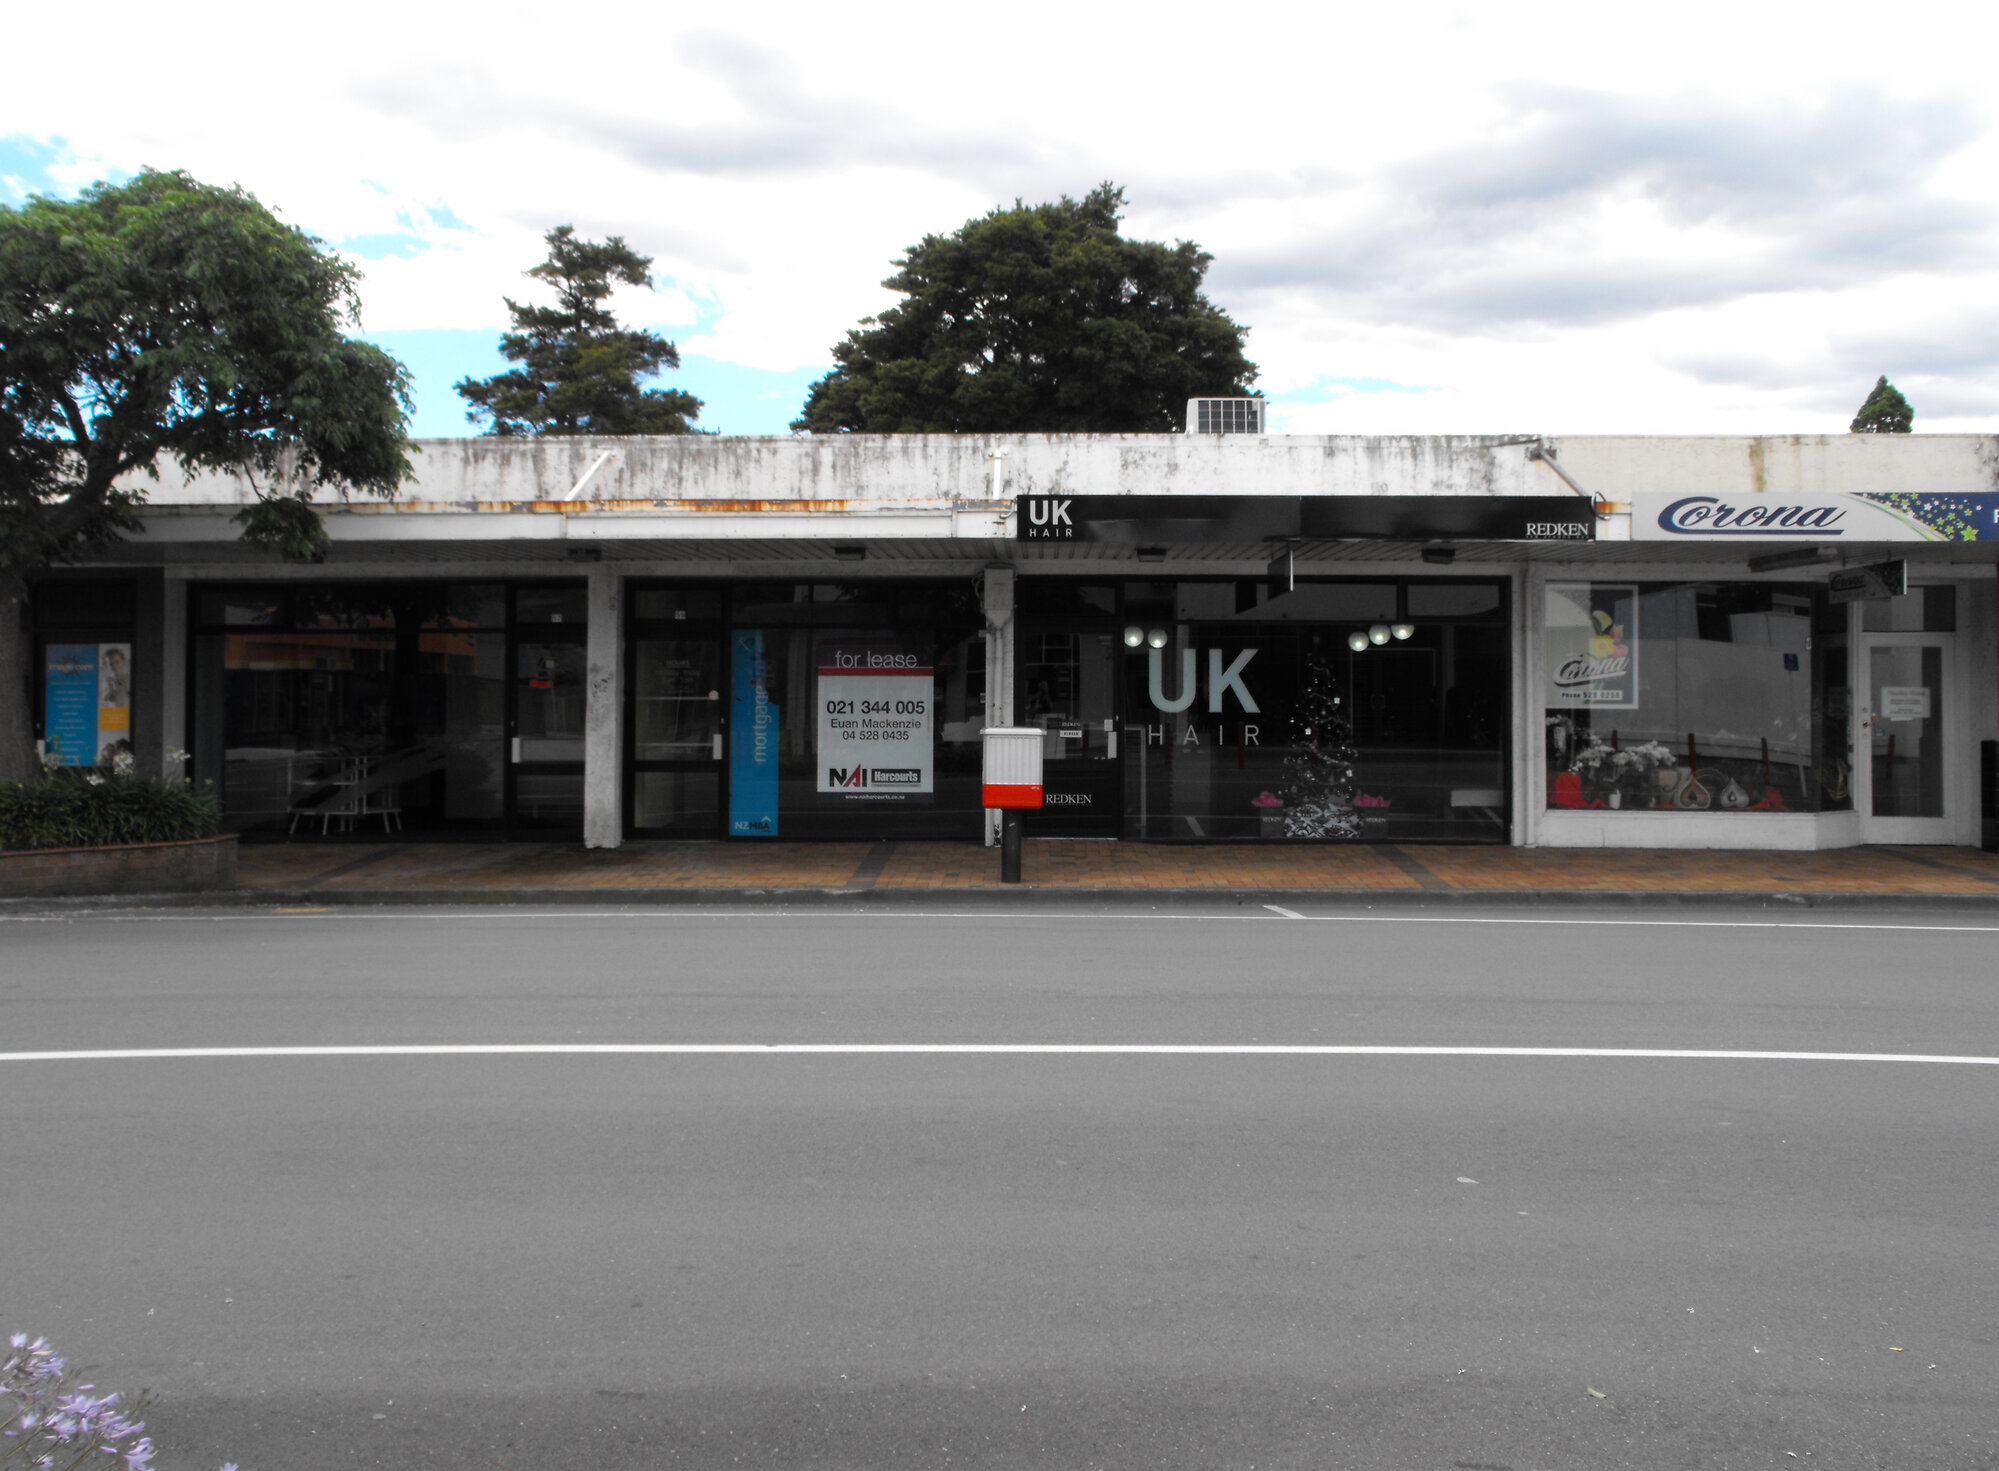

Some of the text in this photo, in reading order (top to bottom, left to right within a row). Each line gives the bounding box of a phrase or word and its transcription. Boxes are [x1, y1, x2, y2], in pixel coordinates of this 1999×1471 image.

[1029, 500, 1073, 526] UK
[1657, 496, 1848, 536] Corona
[1029, 528, 1073, 538] HAIR
[1526, 523, 1589, 536] REDKEN
[834, 650, 917, 668] for lease
[1148, 648, 1260, 713] UK
[827, 701, 925, 714] 021 344 005
[831, 719, 921, 729] Euan Mackenzie
[842, 731, 909, 740] 04 528 0435
[1148, 725, 1260, 746] HAIR
[829, 764, 919, 787] NAI Harcourts
[1046, 794, 1092, 804] REDKEN
